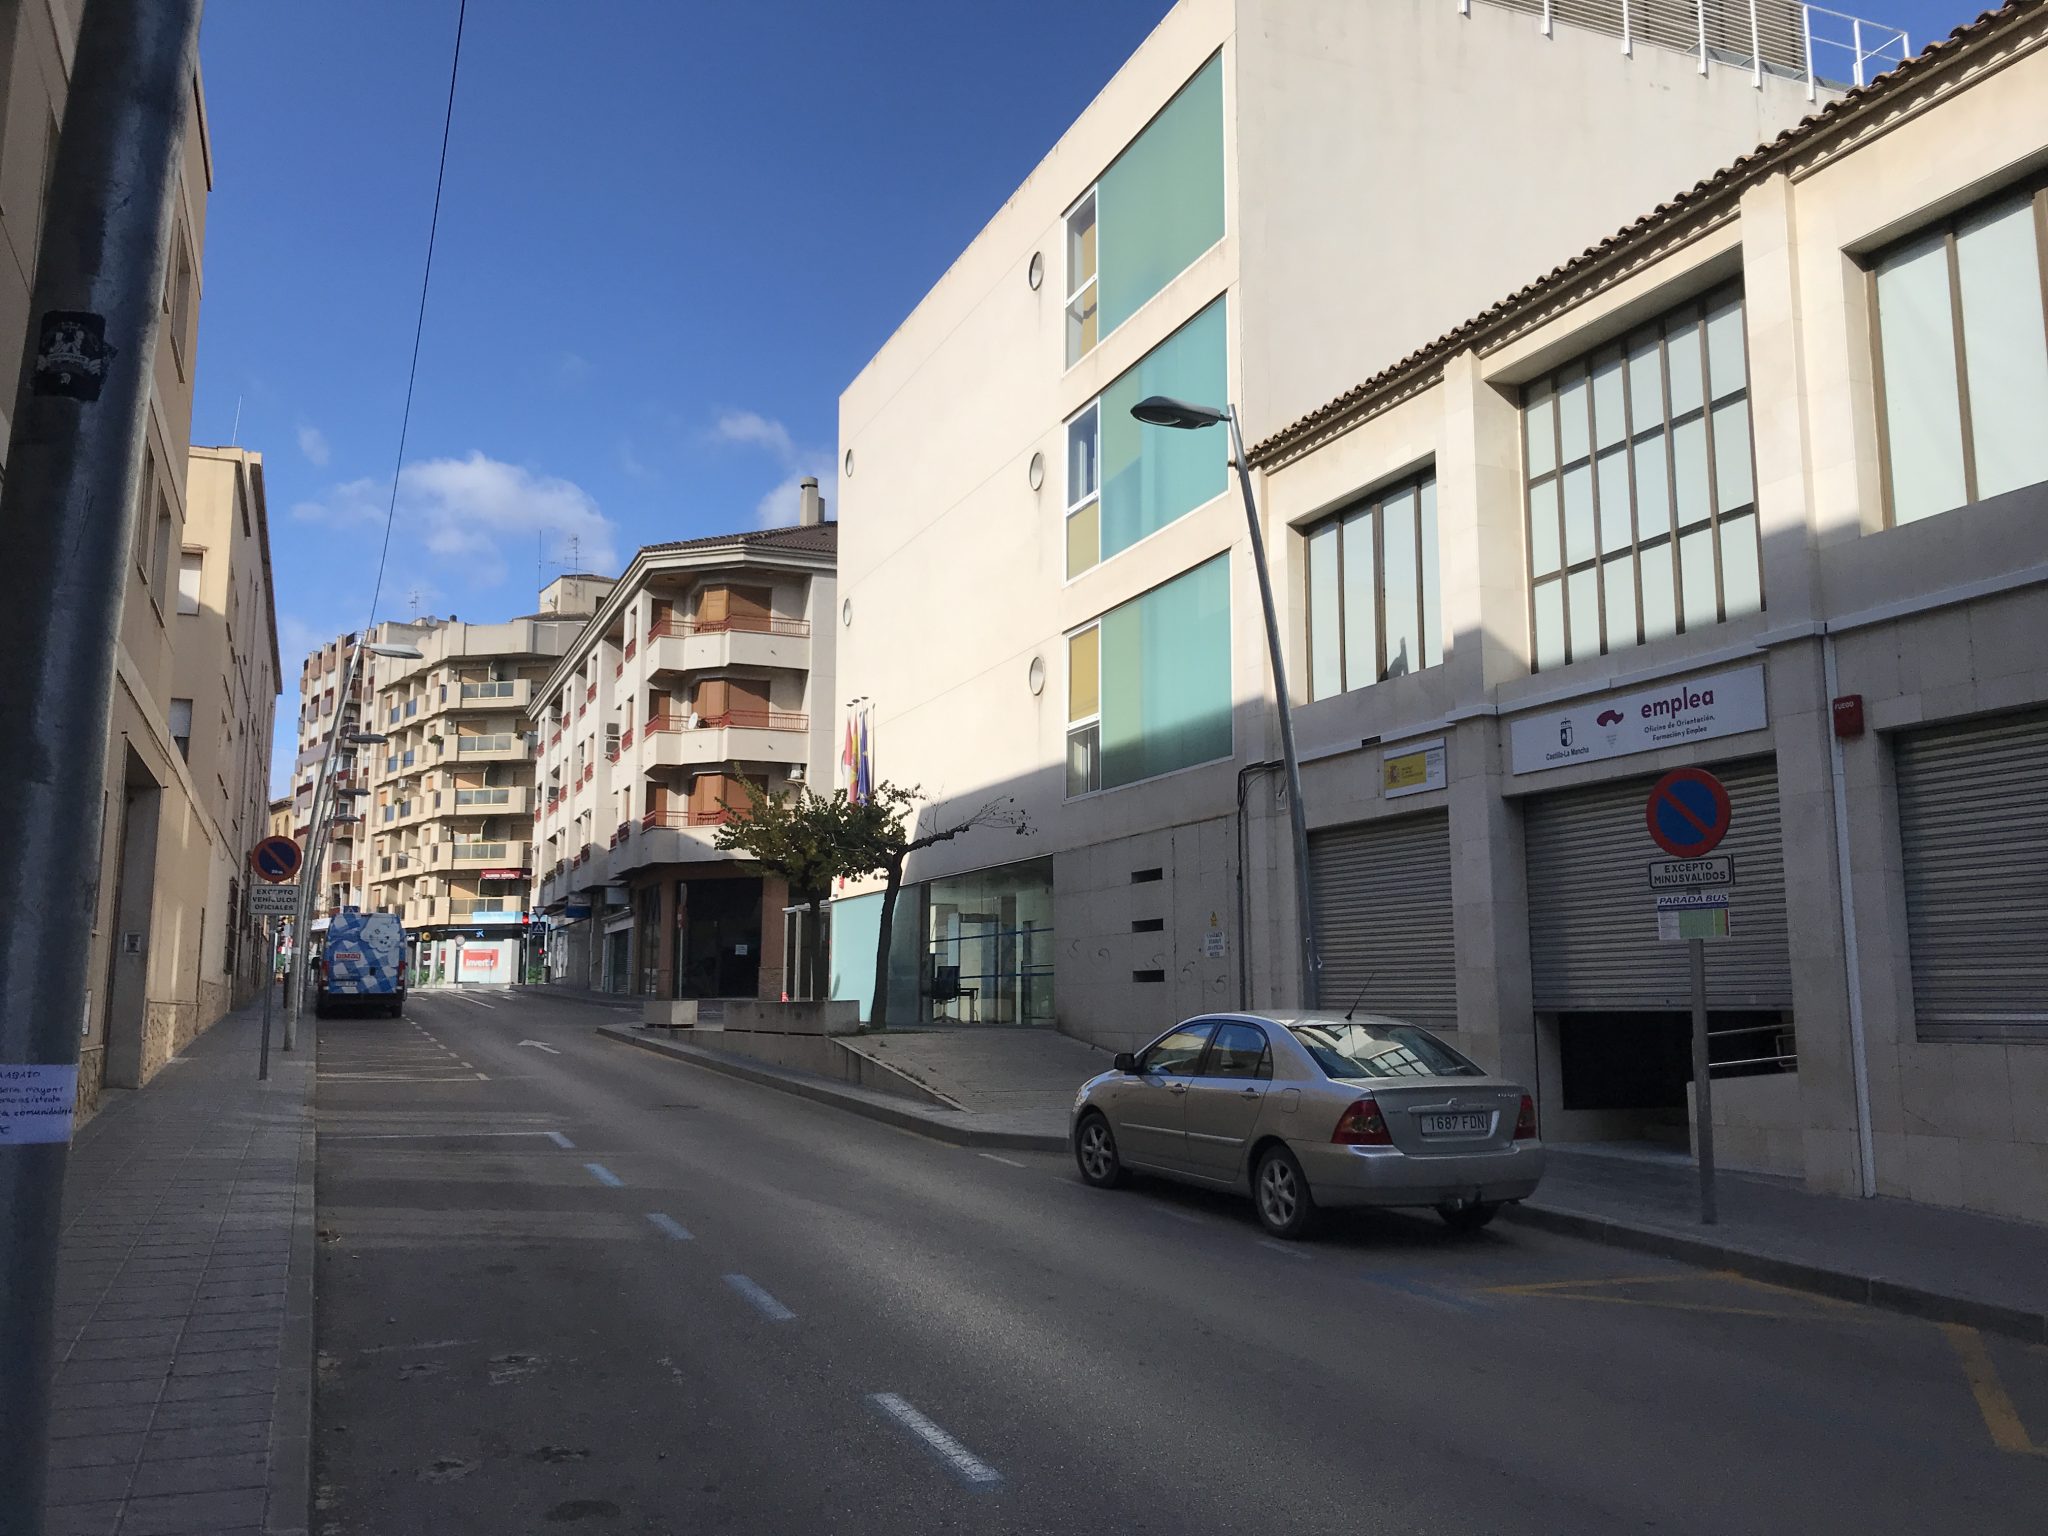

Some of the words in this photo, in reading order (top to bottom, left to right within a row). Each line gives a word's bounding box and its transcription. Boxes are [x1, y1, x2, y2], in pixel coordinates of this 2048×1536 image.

[1641, 687, 1714, 719] emplea
[1644, 725, 1667, 734] Oficina
[1667, 721, 1675, 729] de
[1686, 726, 1708, 737] Empleo
[1664, 861, 1713, 874] EXCEPTO
[1654, 871, 1726, 884] MINUSVALIDOS
[1659, 895, 1703, 905] PARADA
[1705, 894, 1728, 902] BUS
[1430, 1115, 1459, 1131] 1687
[1462, 1114, 1486, 1130] FDN
